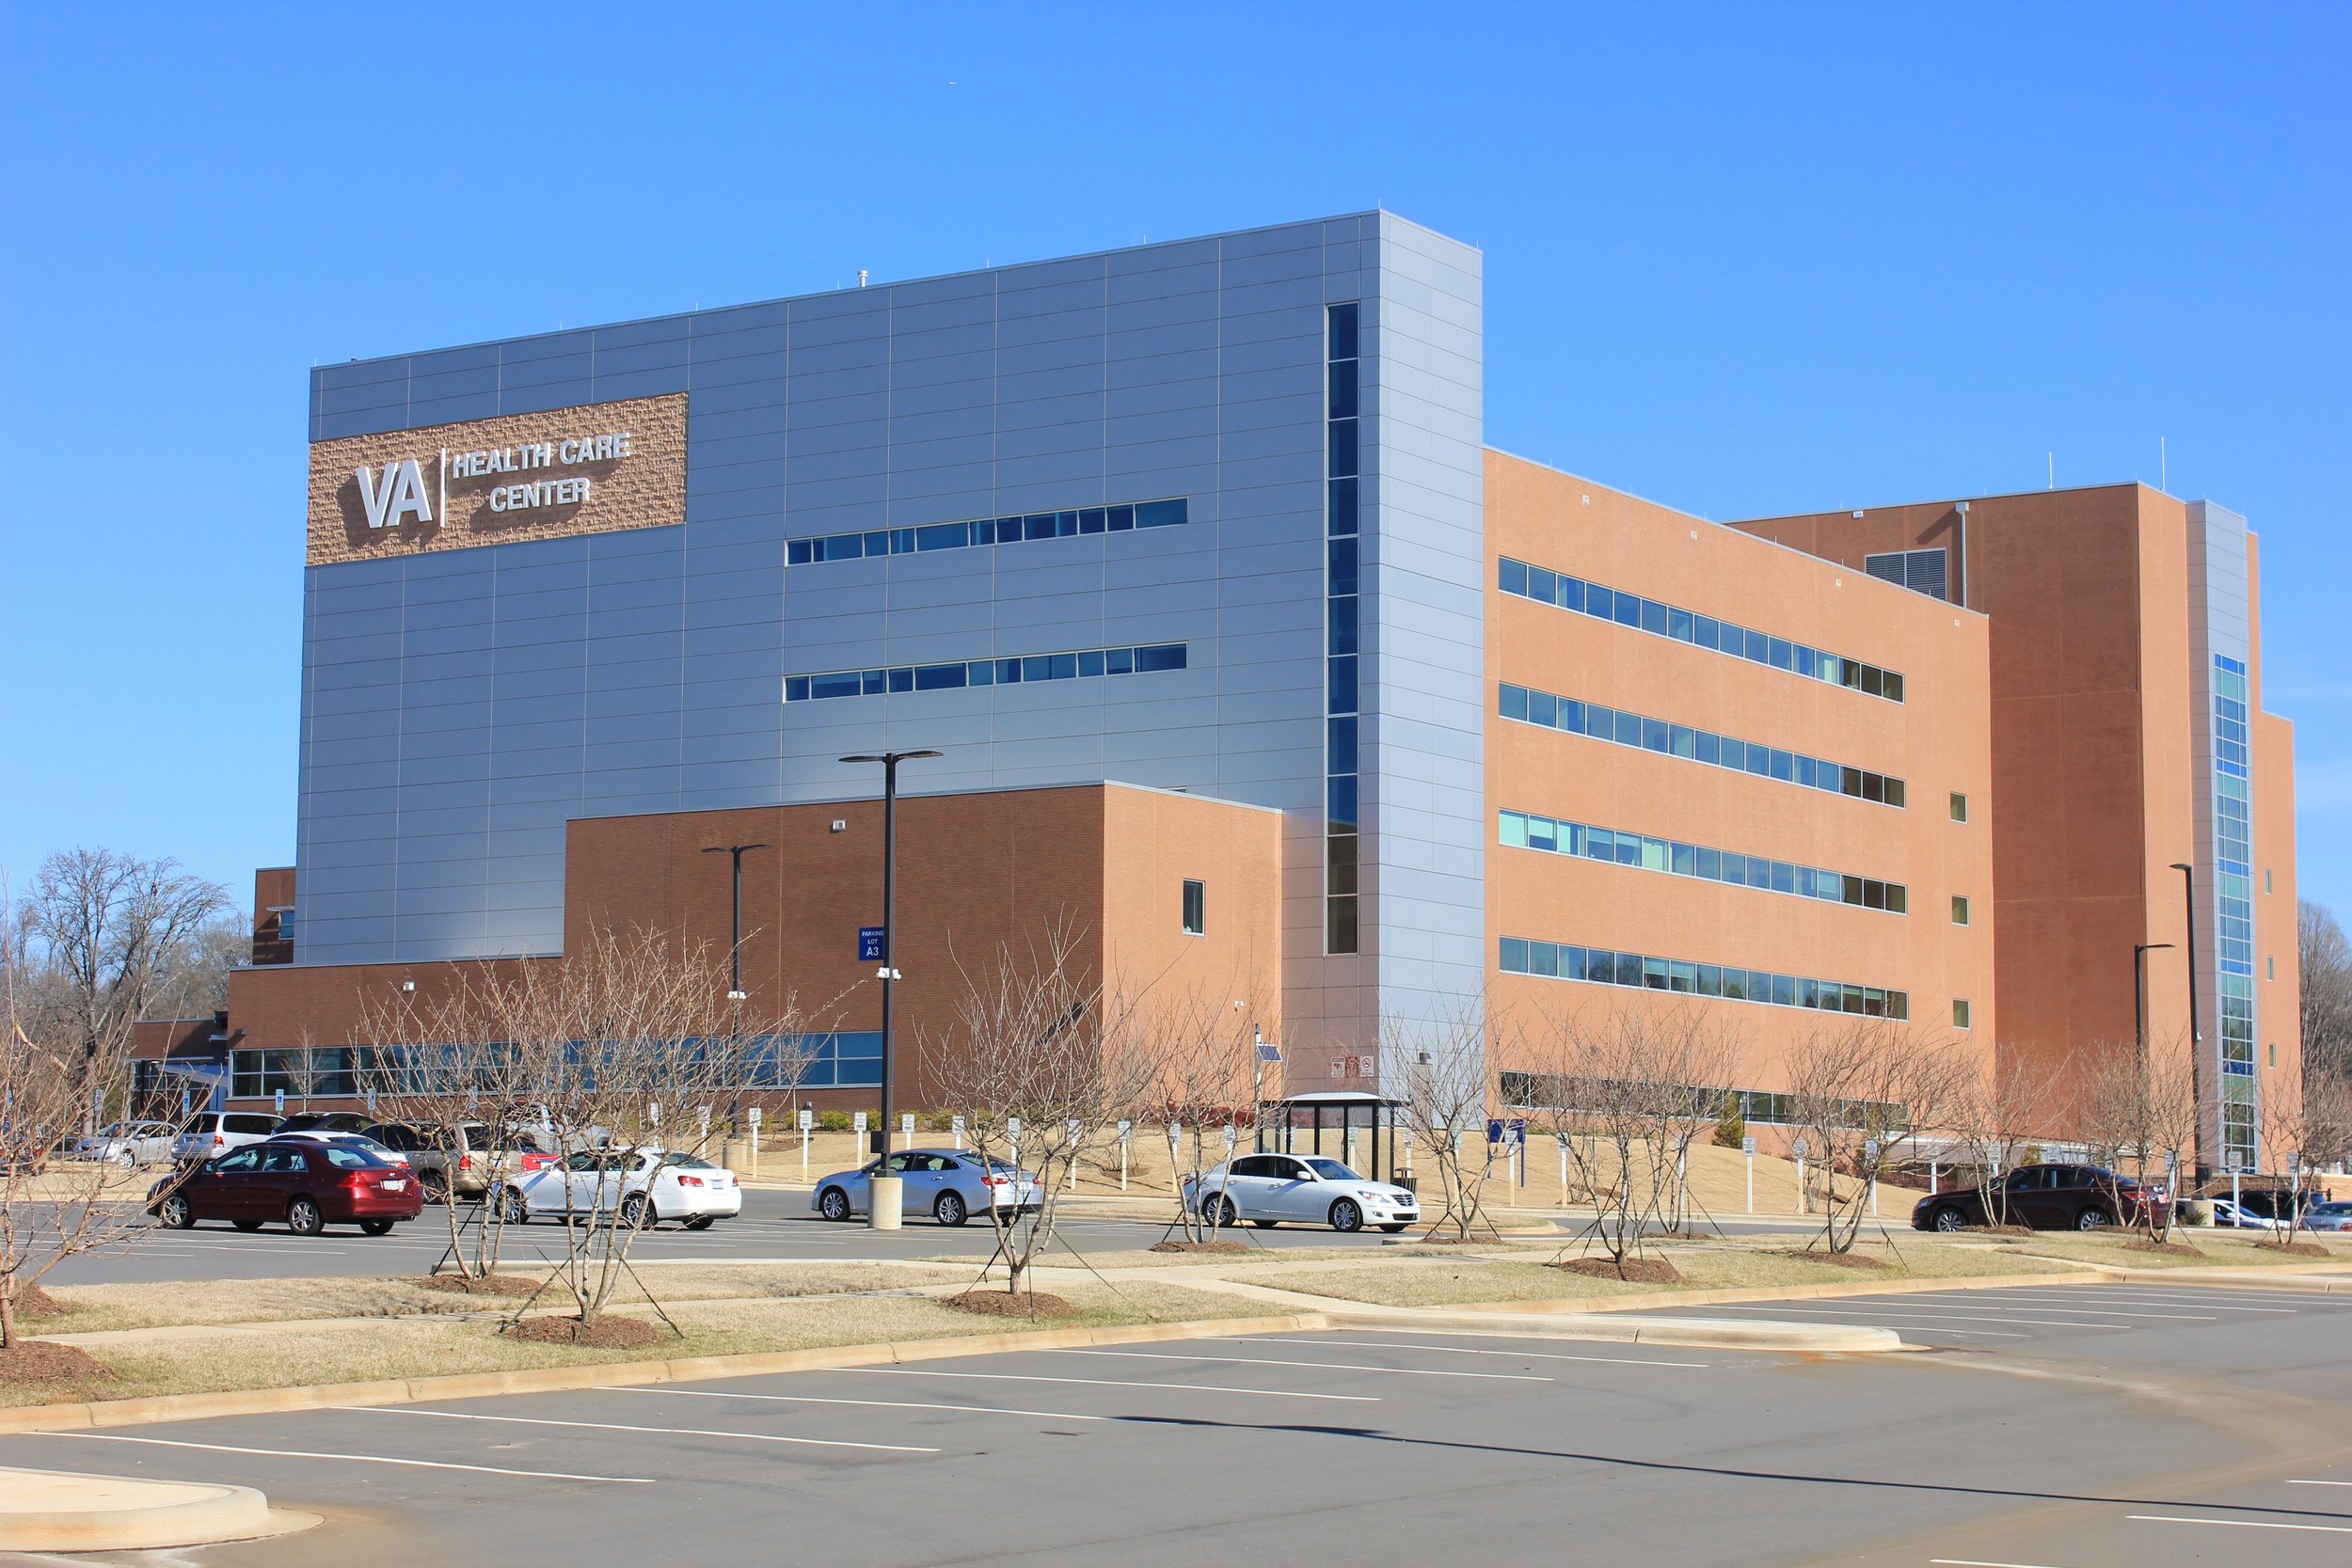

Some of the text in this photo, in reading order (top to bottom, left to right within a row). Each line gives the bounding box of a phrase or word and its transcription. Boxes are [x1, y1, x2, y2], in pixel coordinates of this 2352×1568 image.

[453, 432, 630, 479] HEALTH CARE
[355, 459, 433, 529] VA
[489, 477, 591, 513] CENTER
[866, 946, 879, 957] A3
